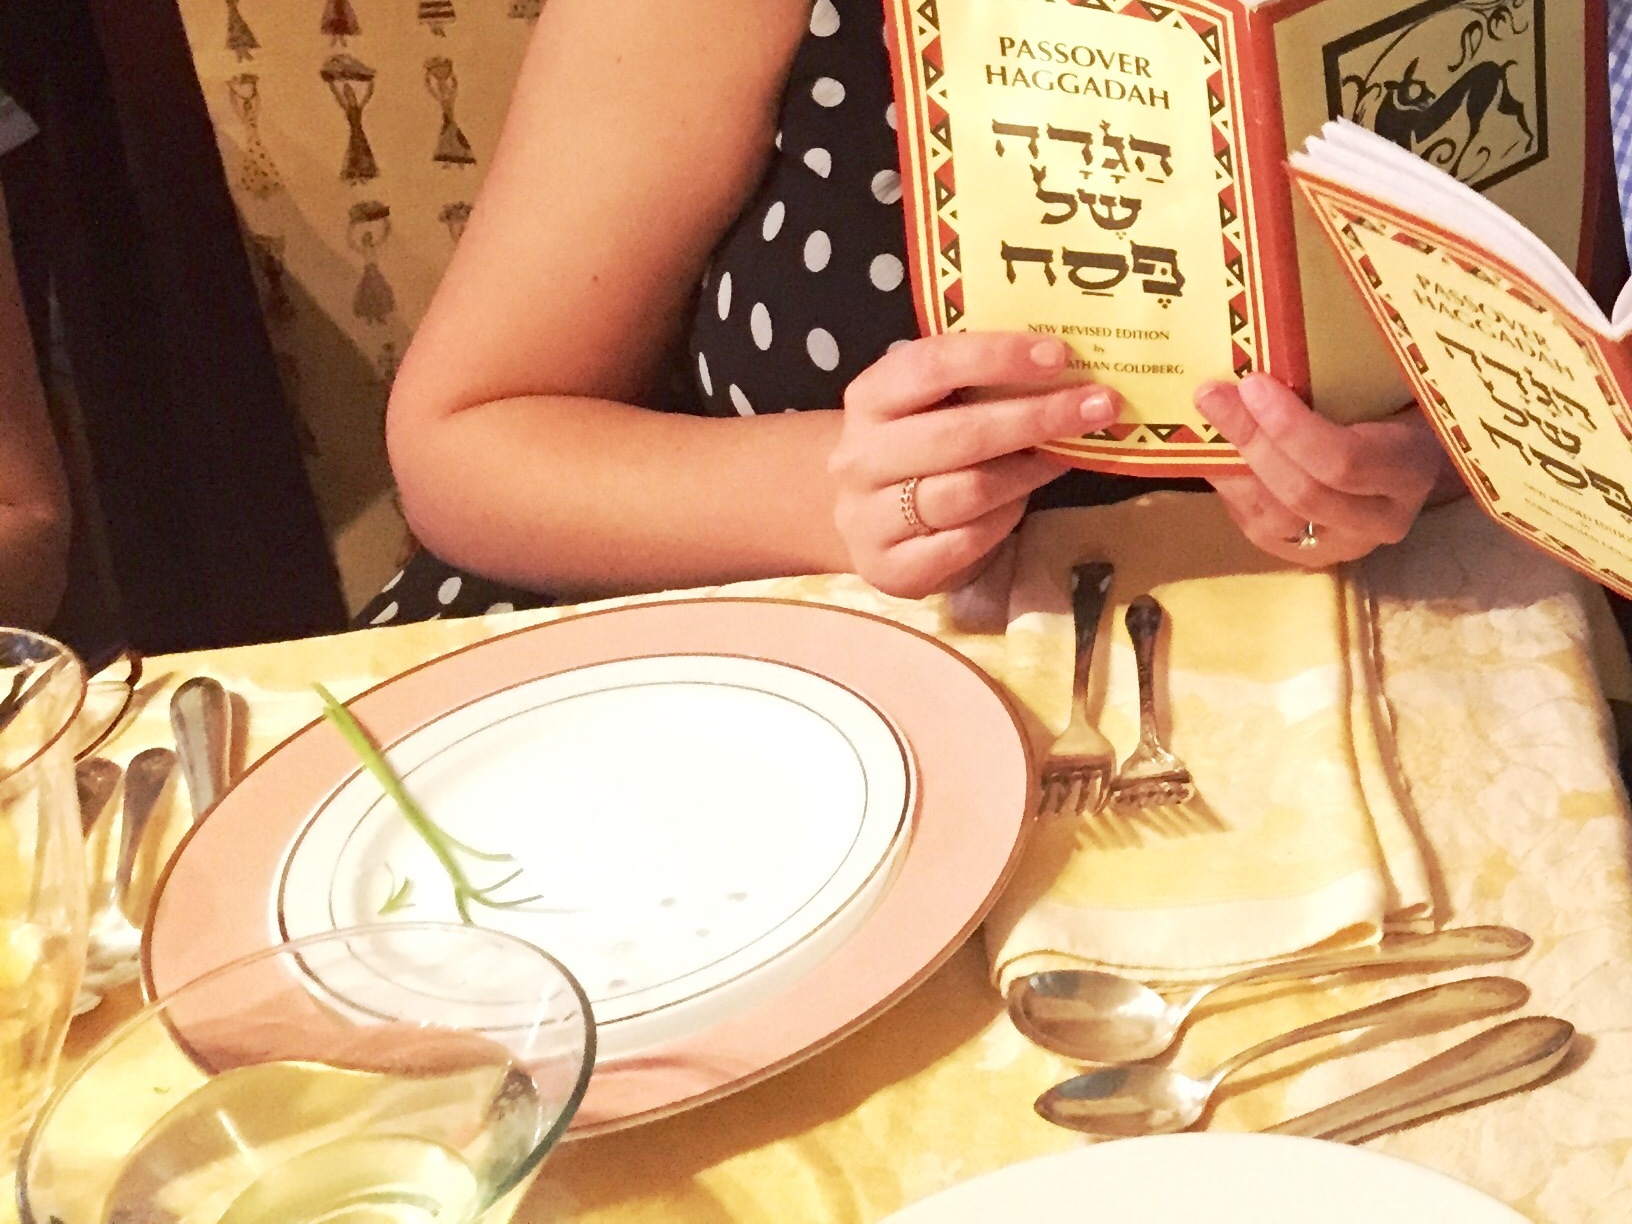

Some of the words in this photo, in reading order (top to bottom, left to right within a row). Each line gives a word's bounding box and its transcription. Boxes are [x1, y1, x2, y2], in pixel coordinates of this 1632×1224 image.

[1000, 36, 1152, 78] PASSOVER
[985, 64, 1170, 110] HAGGADAH
[1027, 322, 1058, 335] NEW
[1061, 324, 1112, 338] REVISED
[1115, 327, 1170, 340] EDITION
[1415, 272, 1551, 352] PASSOVER
[1412, 288, 1575, 381] HAGGADAH
[1066, 358, 1110, 372] ATHAN
[1113, 362, 1185, 375] GOLDBERG
